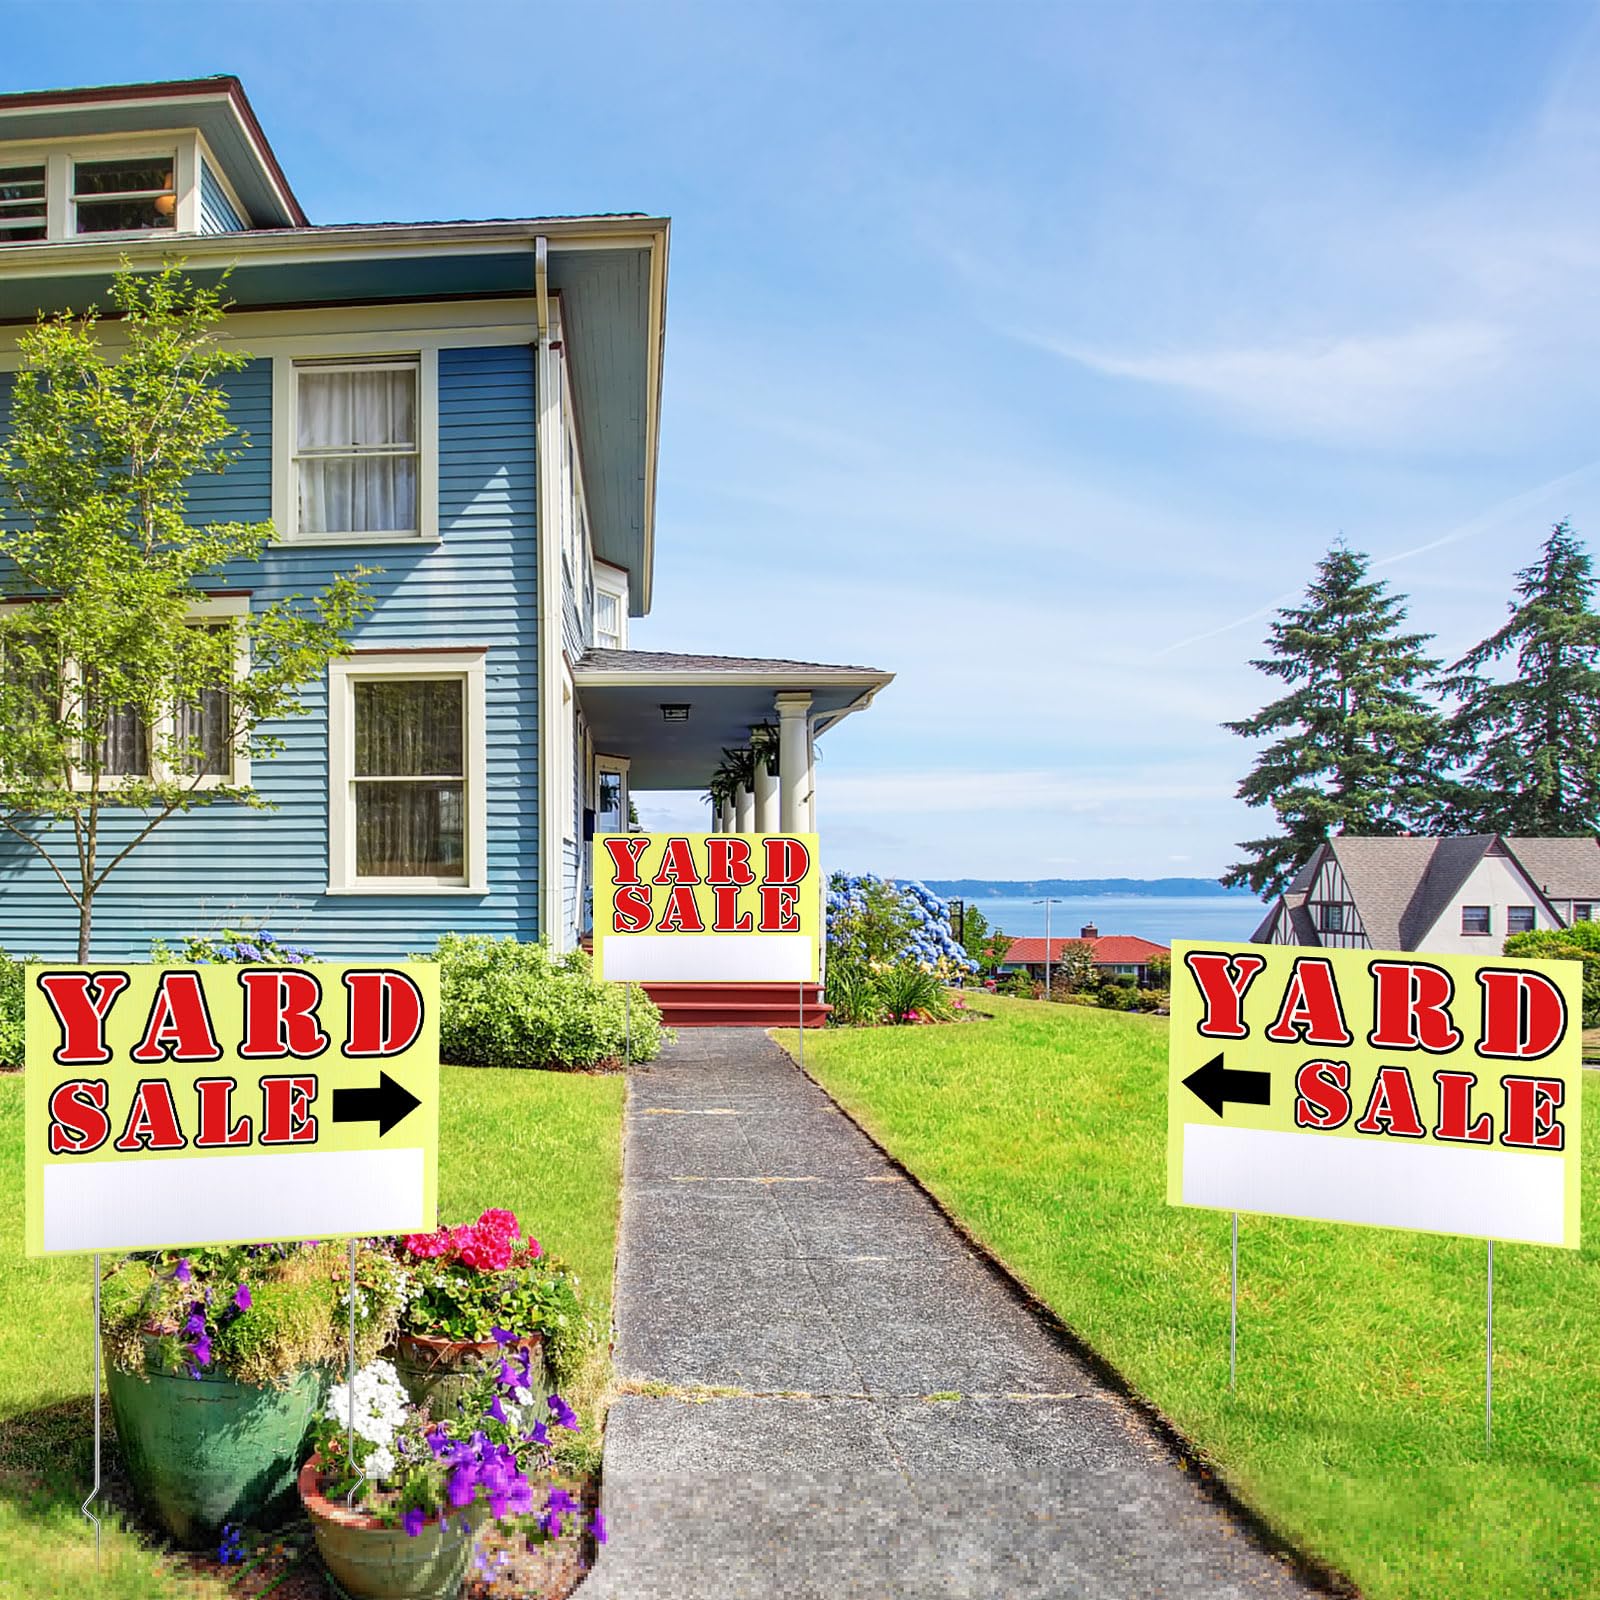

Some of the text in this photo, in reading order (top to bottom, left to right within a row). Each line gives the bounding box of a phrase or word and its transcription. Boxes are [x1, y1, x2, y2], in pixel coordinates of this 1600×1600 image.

[604, 837, 810, 886] YARD
[613, 884, 800, 933] SALE
[37, 969, 425, 1064] YARD
[1184, 951, 1568, 1061] YARD
[47, 1073, 319, 1154] SALE
[1295, 1059, 1565, 1151] SALE
